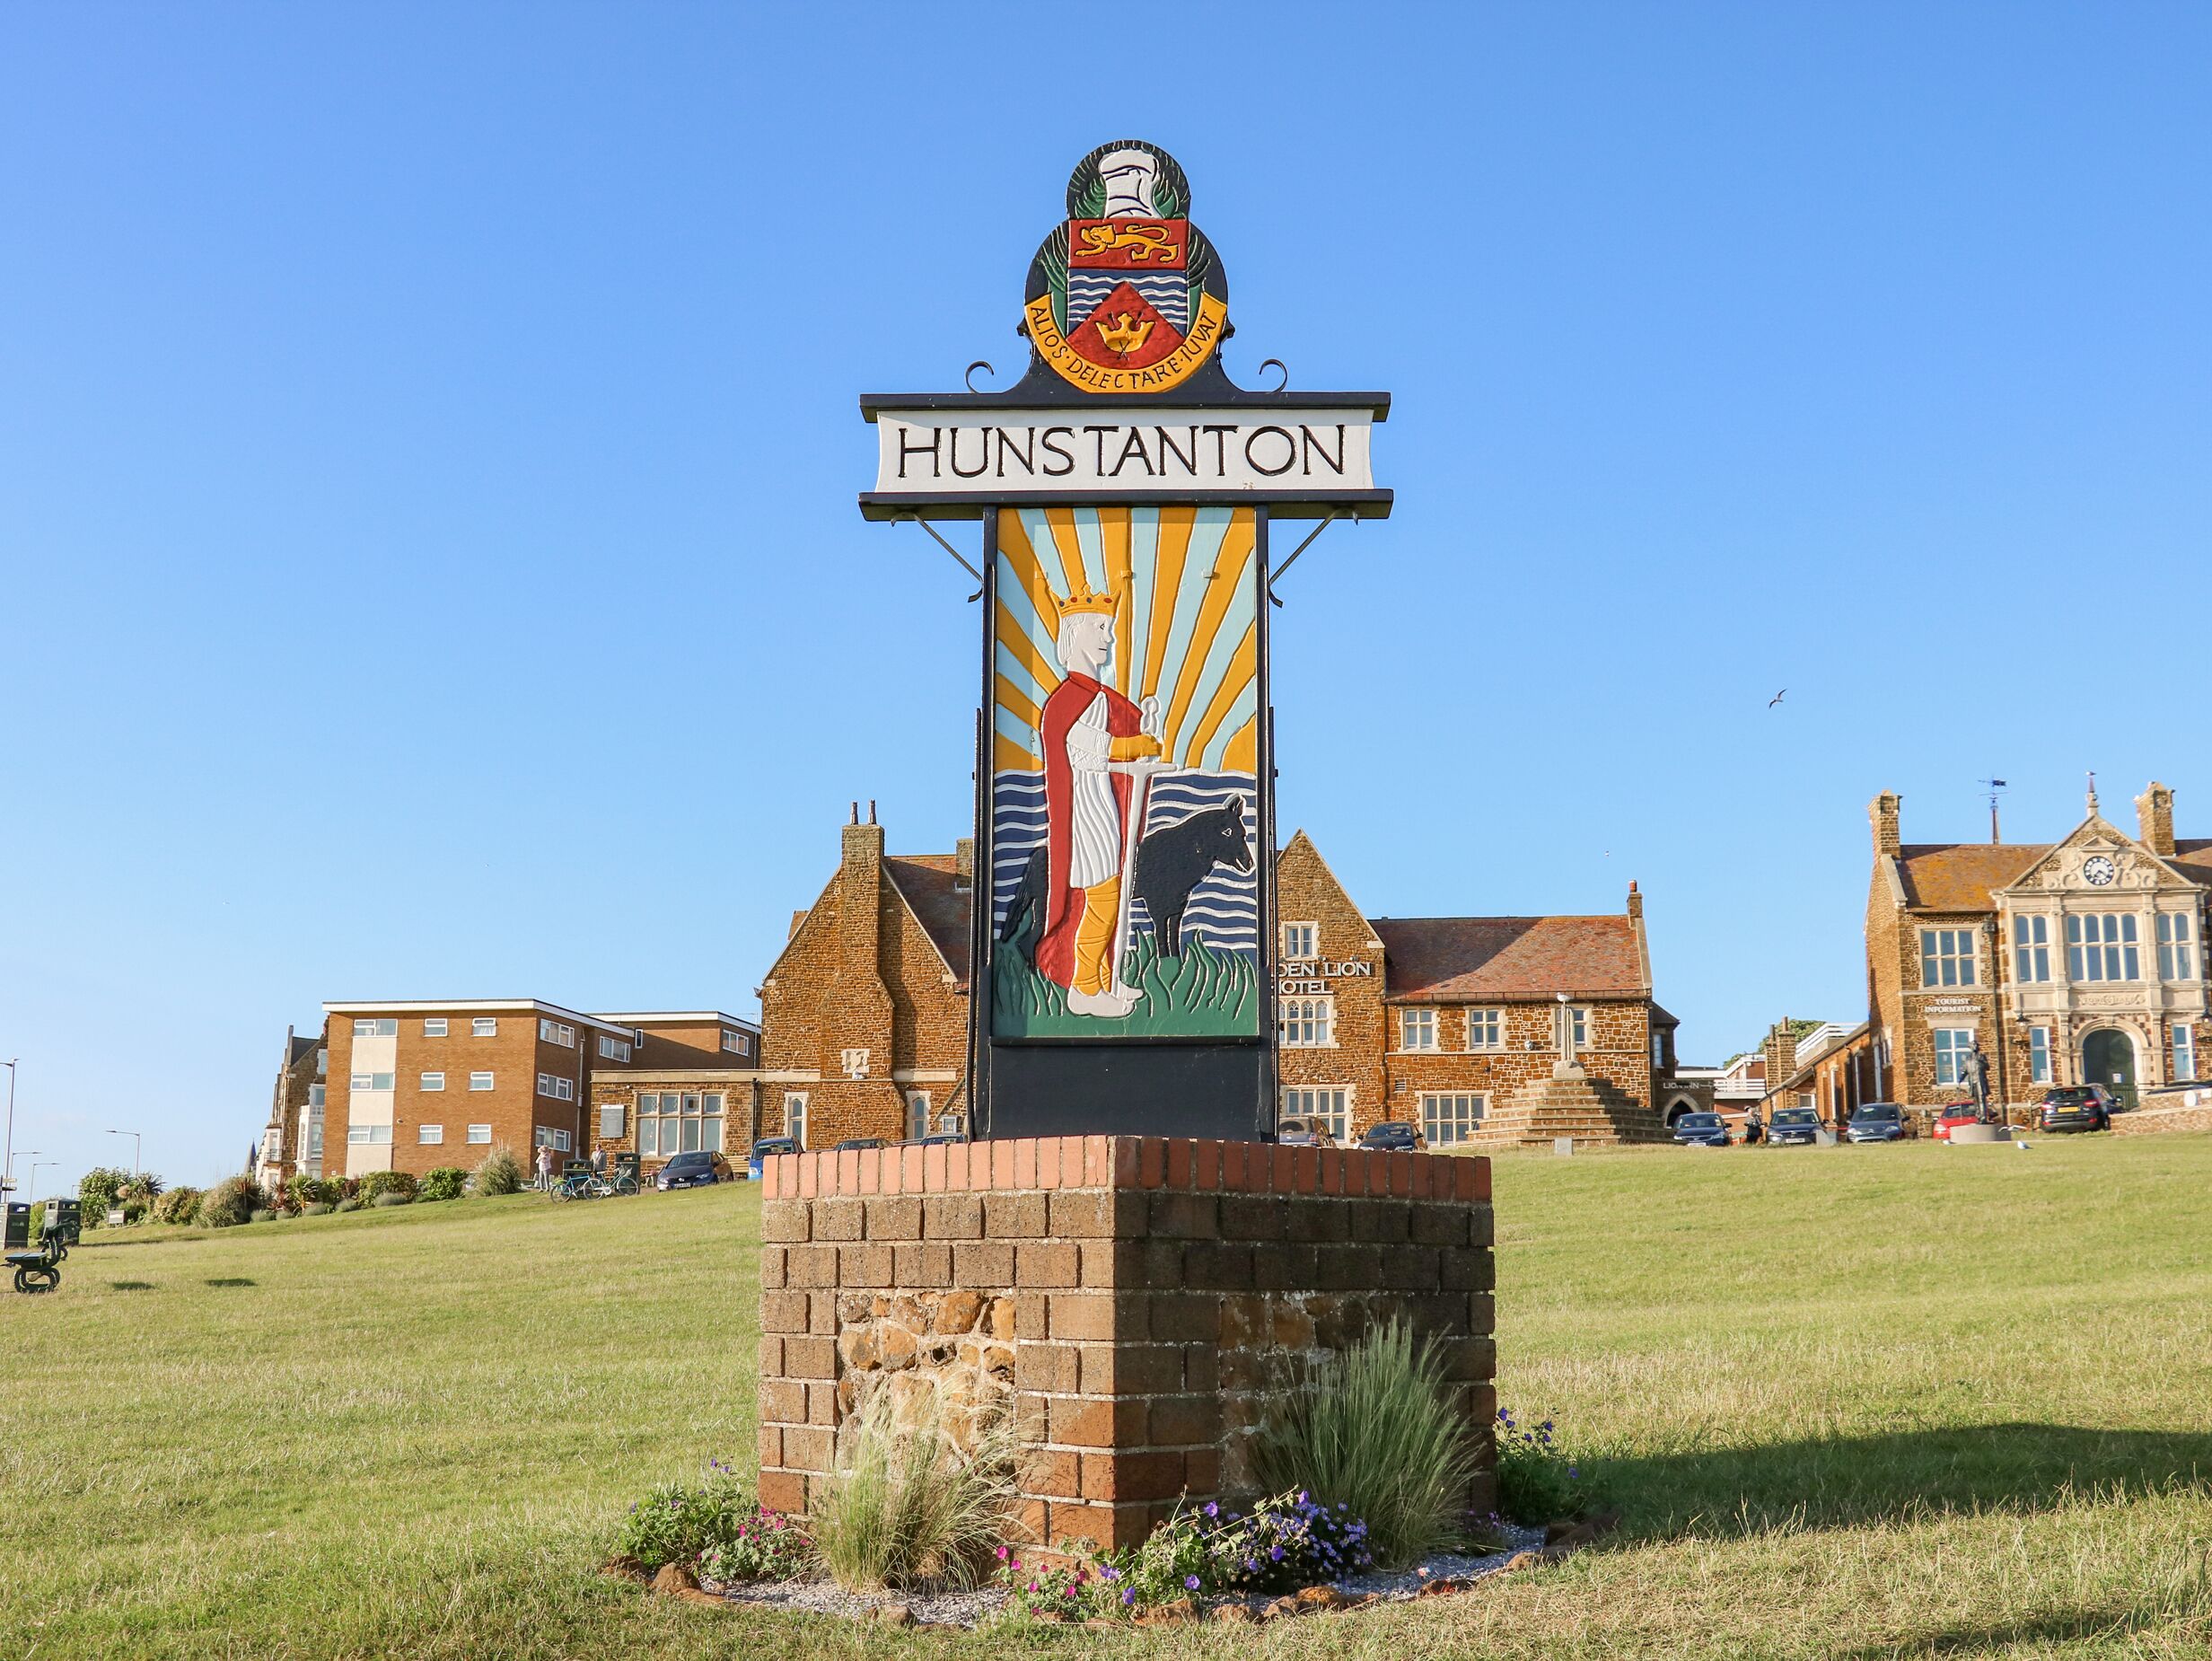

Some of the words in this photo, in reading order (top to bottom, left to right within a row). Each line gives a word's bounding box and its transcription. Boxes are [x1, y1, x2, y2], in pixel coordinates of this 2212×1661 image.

[1030, 306, 1068, 359] ALIOS
[1066, 357, 1183, 390] DELECTARE
[897, 425, 1346, 478] HUNSTANTON
[1323, 962, 1372, 977] LION
[1278, 980, 1334, 995] OTEL
[1935, 997, 1971, 1006] TOURIST
